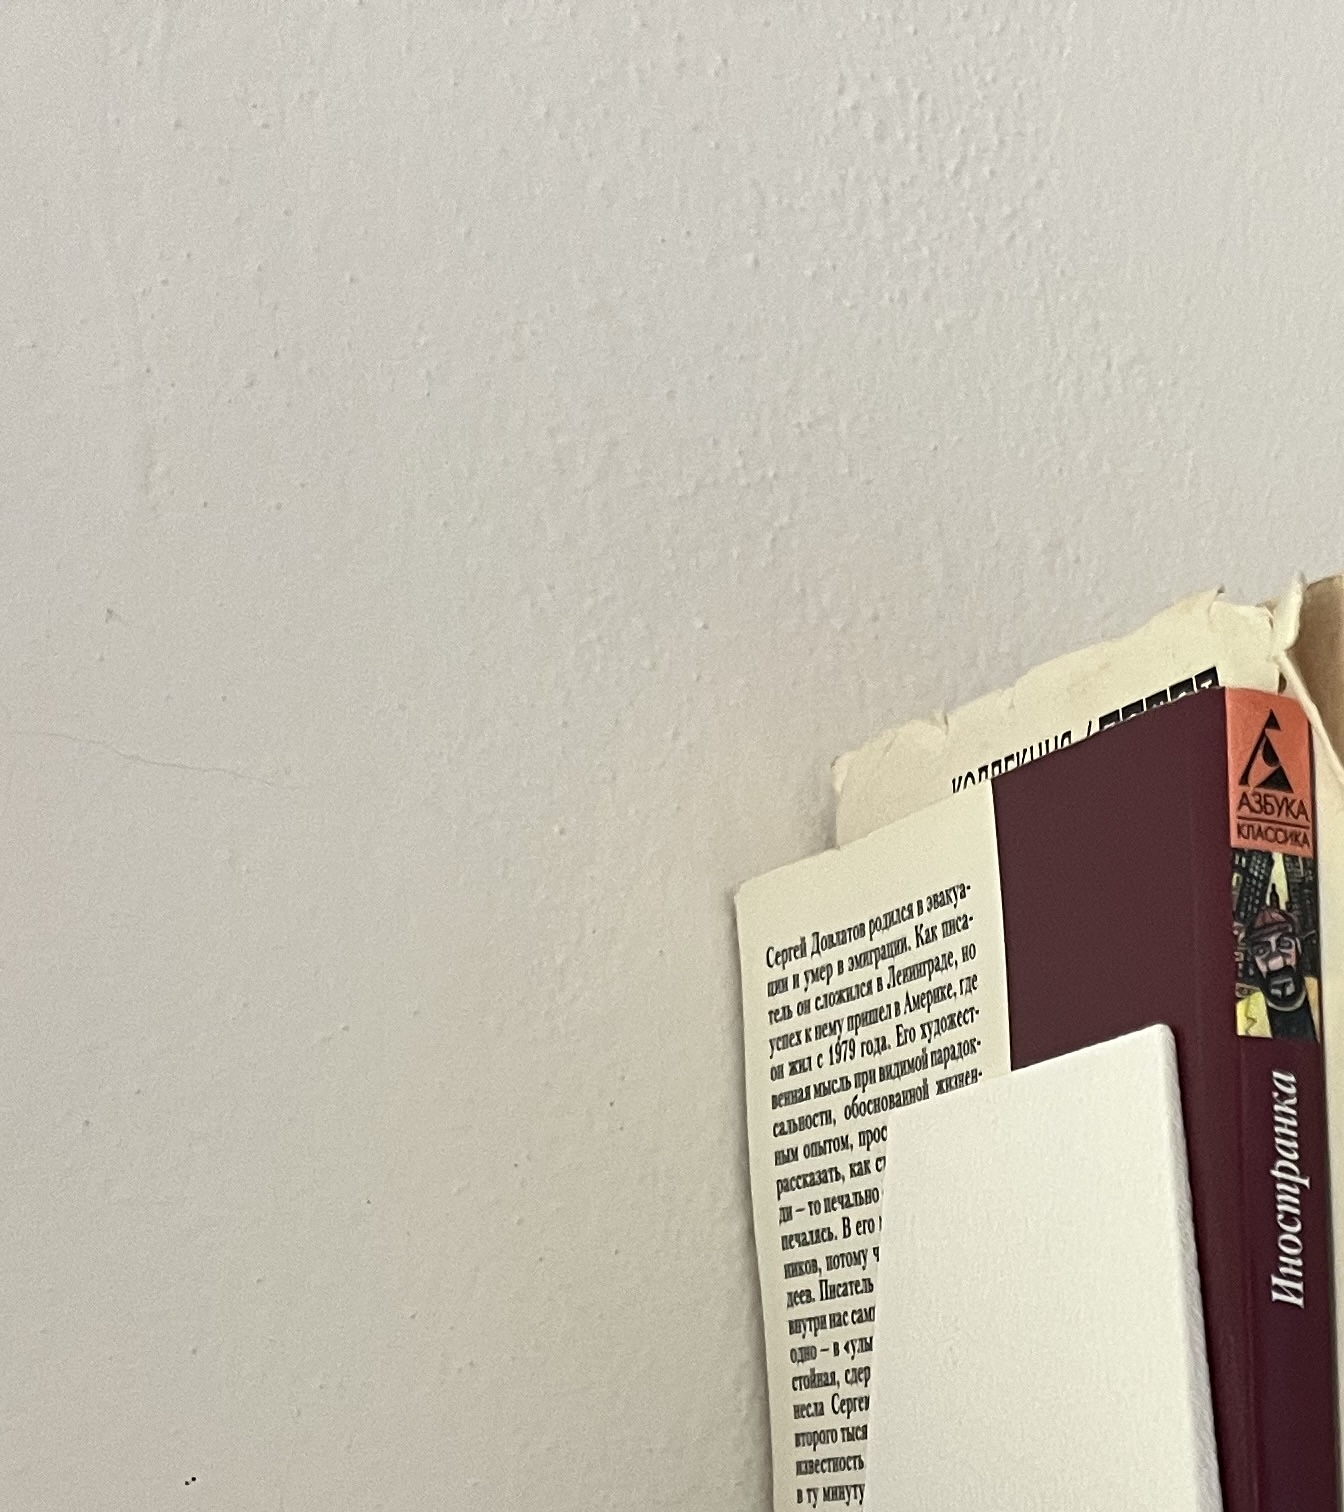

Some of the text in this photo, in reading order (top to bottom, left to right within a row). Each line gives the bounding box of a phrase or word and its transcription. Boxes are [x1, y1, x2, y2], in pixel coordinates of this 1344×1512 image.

[1238, 794, 1310, 822] АЗБУКА
[1237, 823, 1310, 848] КЛАССИКА
[1269, 1070, 1310, 1309] Иностранка
